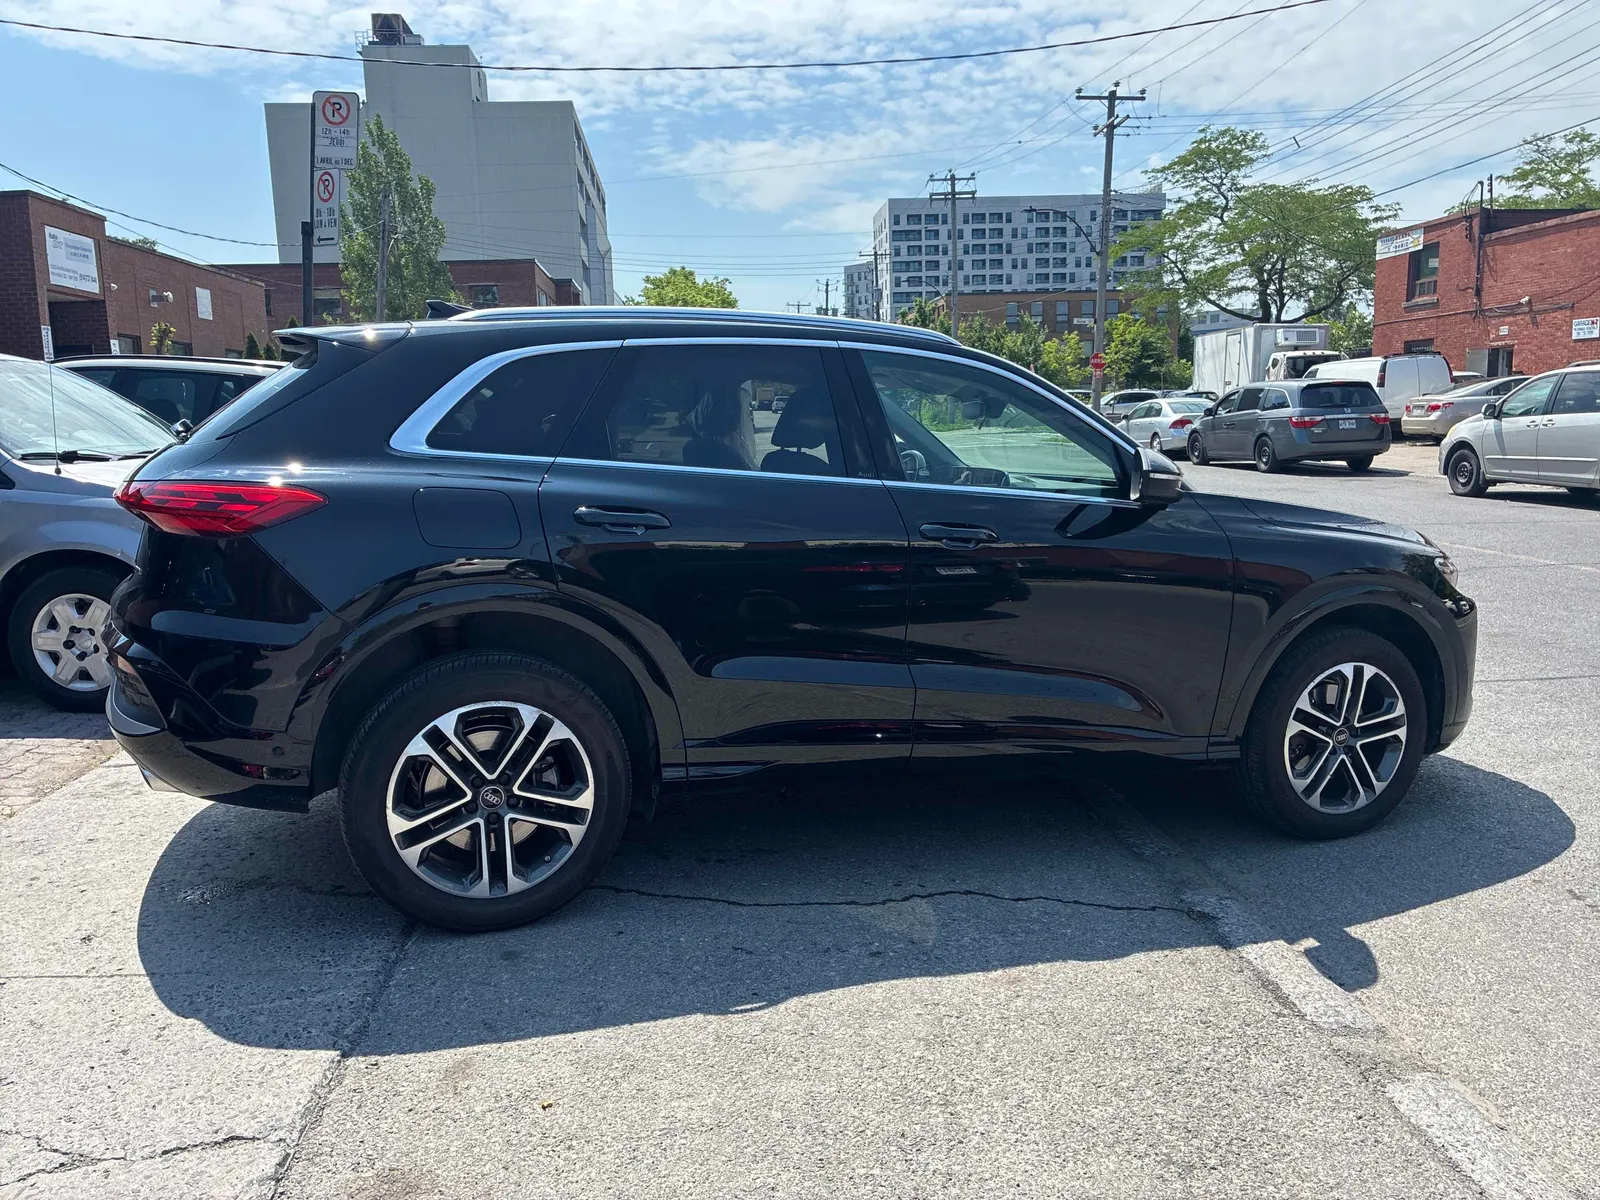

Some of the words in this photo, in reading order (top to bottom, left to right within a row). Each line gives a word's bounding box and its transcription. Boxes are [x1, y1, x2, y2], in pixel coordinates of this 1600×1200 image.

[321, 127, 332, 135] 12h
[339, 128, 350, 136] 14h
[329, 137, 345, 146] JEUDI
[320, 157, 333, 165] AVRIL
[327, 218, 338, 228] VEN
